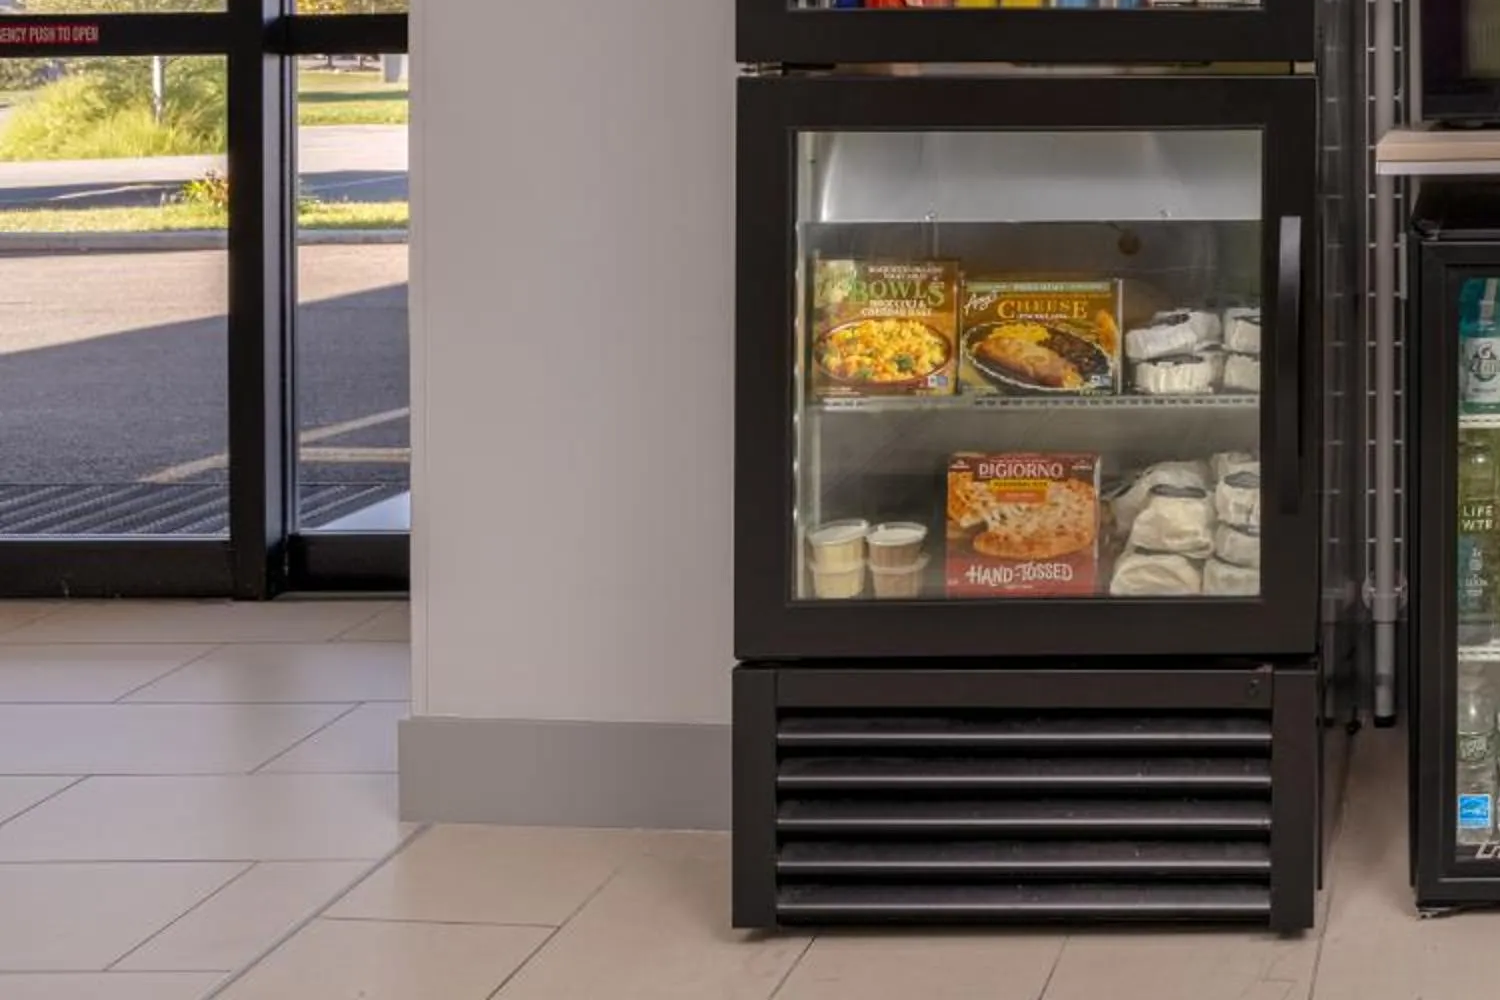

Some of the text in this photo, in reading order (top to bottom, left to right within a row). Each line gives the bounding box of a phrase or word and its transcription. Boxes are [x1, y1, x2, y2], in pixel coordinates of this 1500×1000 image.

[29, 26, 56, 42] PUSH
[58, 26, 71, 41] TO
[72, 26, 99, 41] OPEN
[849, 279, 945, 308] BOWLS
[978, 463, 1064, 479] DIGIORNO
[1464, 505, 1493, 517] LIFE
